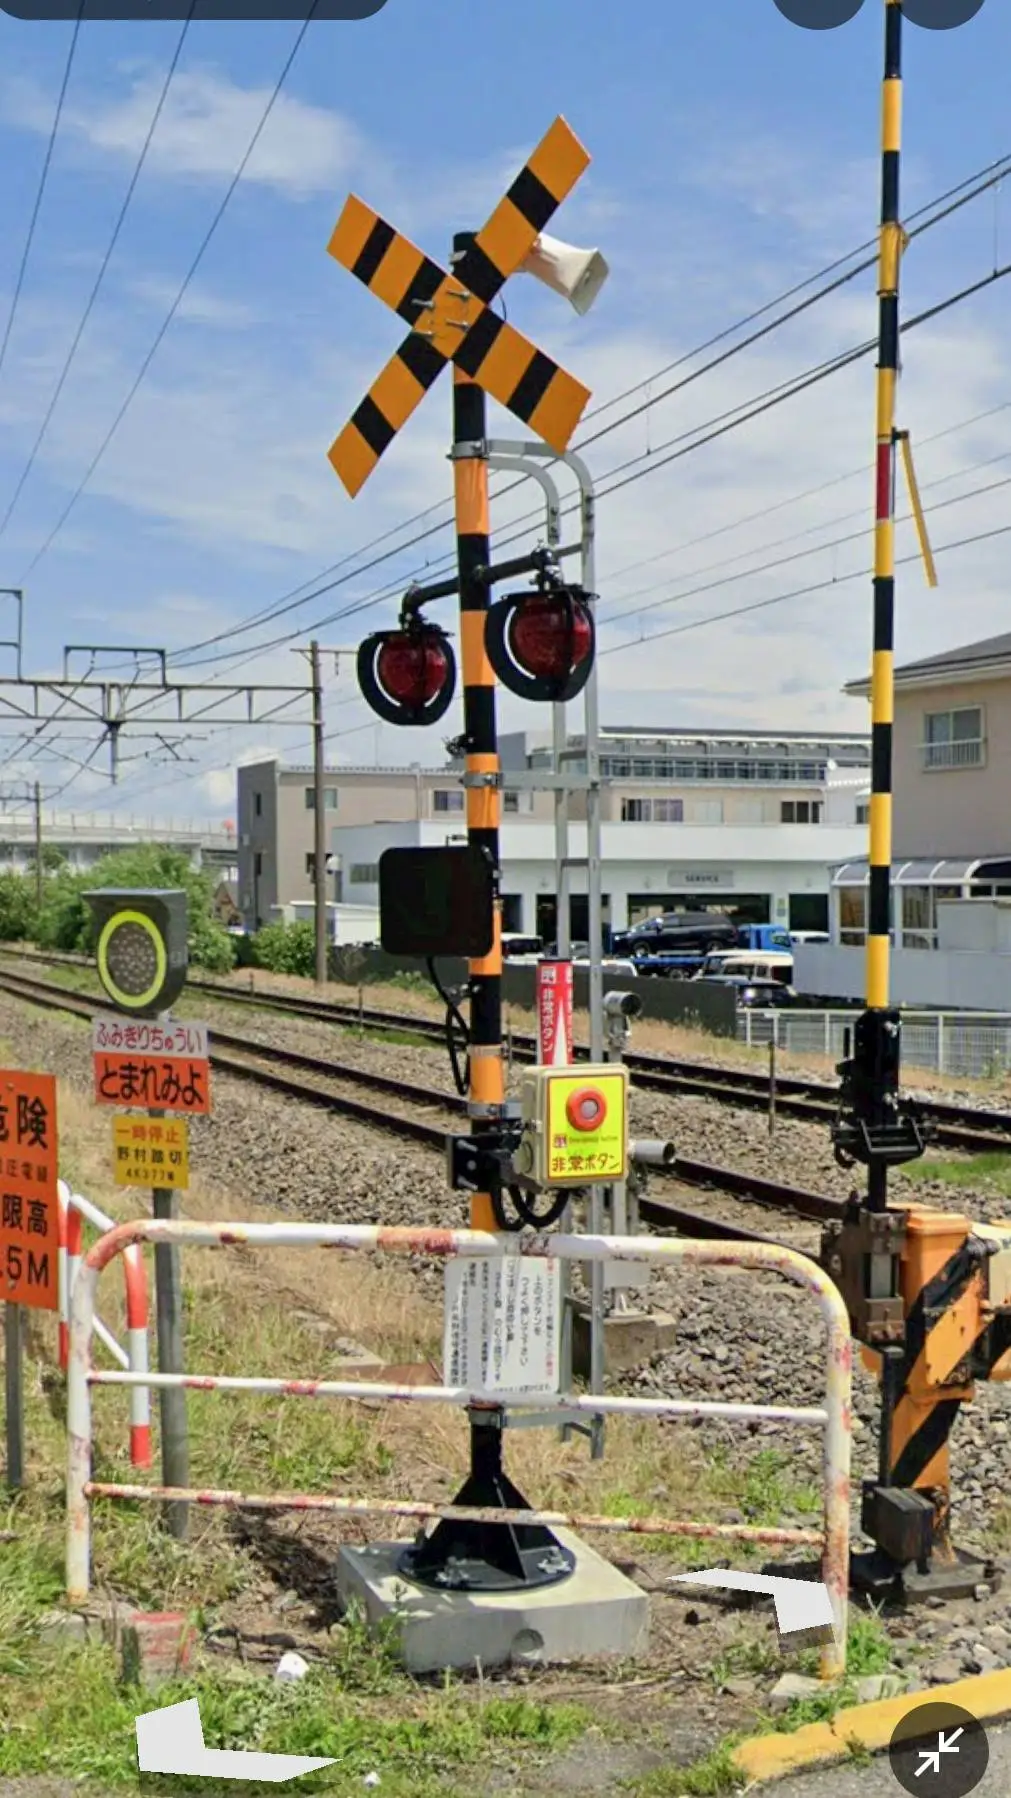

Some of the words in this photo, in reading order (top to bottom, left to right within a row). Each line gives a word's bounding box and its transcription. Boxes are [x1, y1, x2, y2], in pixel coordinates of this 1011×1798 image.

[97, 1023, 202, 1051] ふみきりちゅうい
[100, 1060, 203, 1105] とまれみよ
[116, 1124, 180, 1143] 一時停止
[117, 1146, 182, 1164] 野村踏切
[551, 1153, 620, 1172] 非常ボタン
